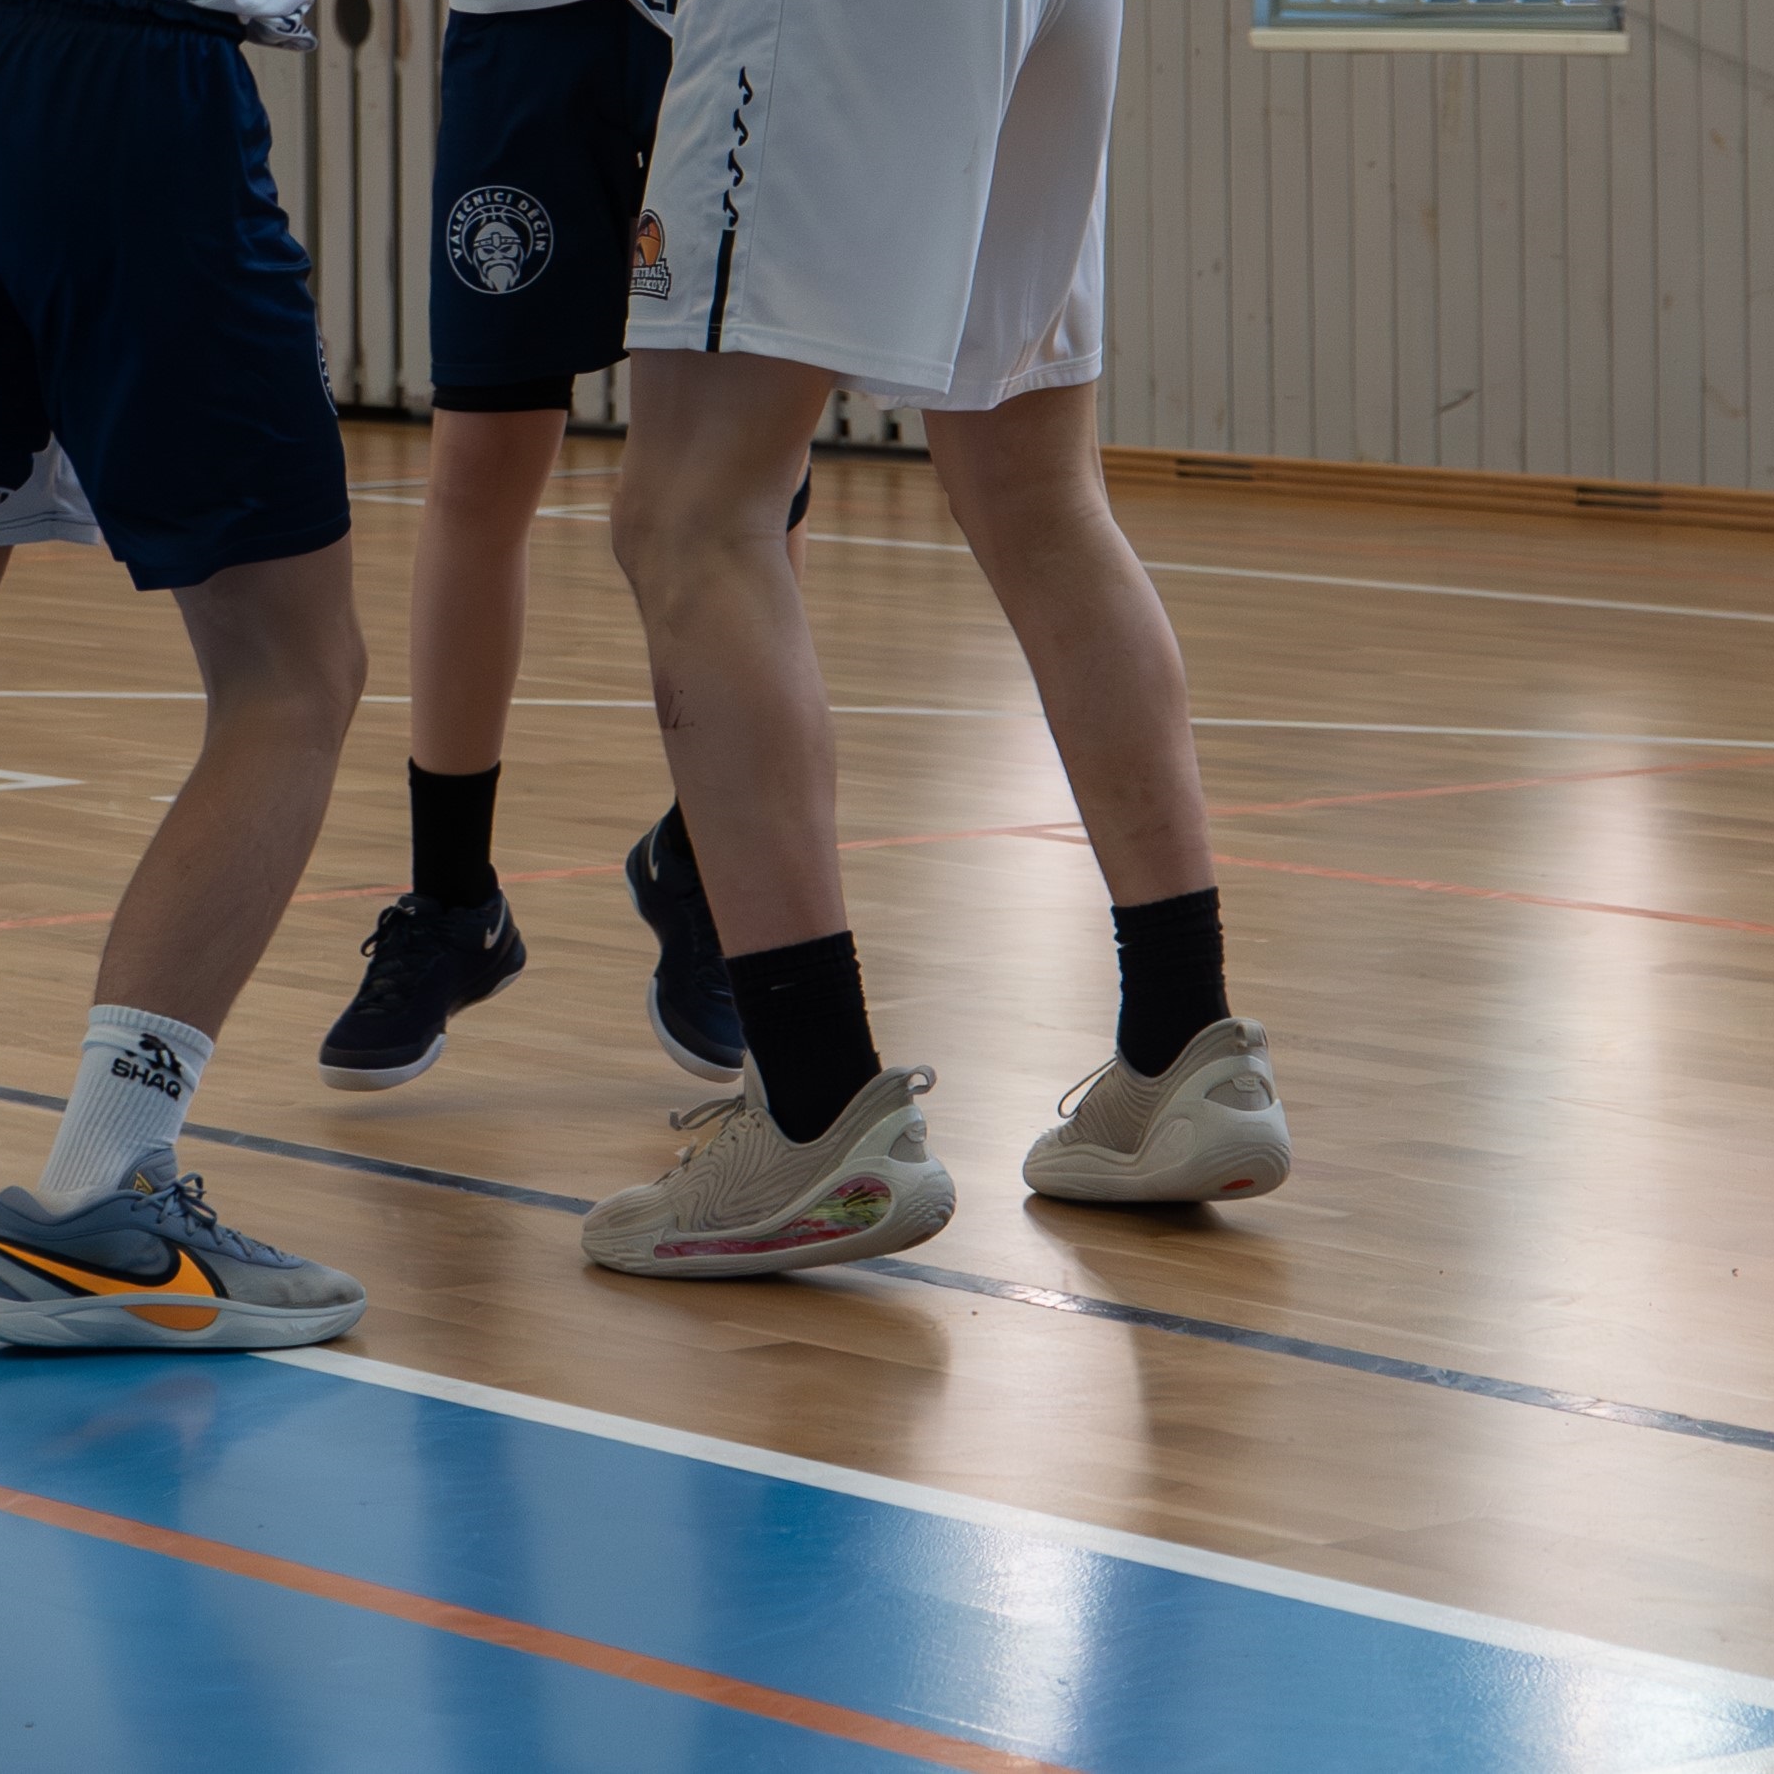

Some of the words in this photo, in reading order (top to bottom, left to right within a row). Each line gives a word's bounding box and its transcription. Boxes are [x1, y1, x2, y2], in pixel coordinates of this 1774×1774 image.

[449, 189, 514, 260] VÁLEČNÍCI
[517, 199, 549, 252] DĚČÍN
[110, 1056, 182, 1102] SHAQ
